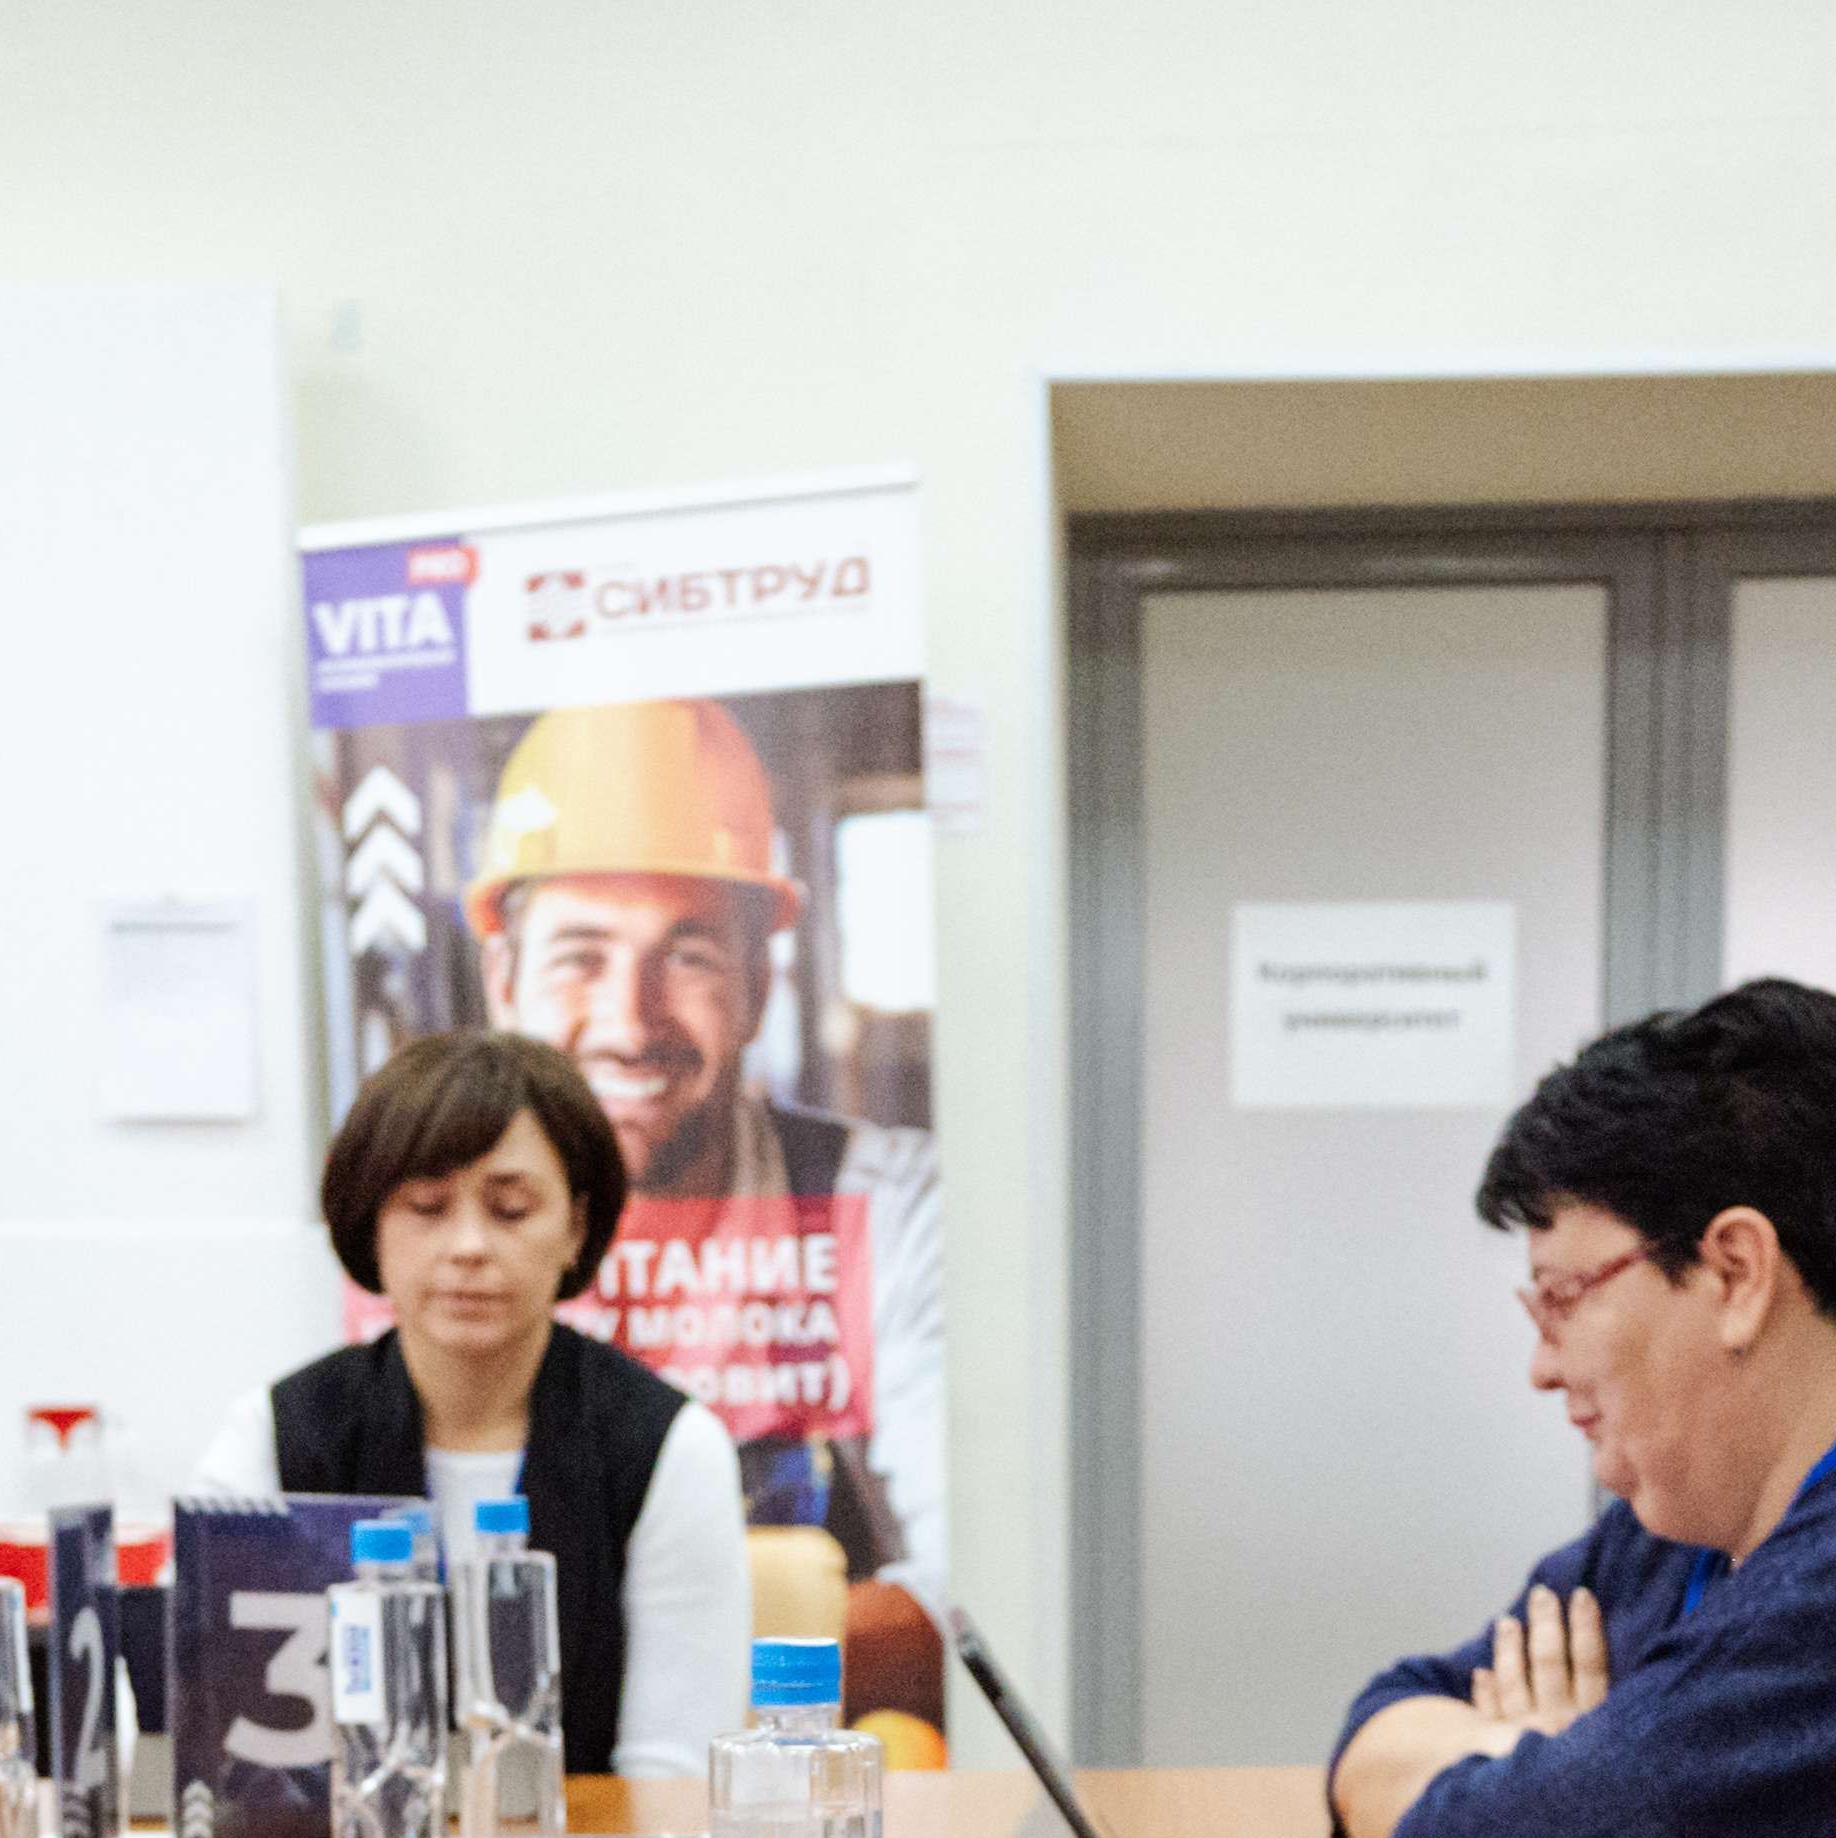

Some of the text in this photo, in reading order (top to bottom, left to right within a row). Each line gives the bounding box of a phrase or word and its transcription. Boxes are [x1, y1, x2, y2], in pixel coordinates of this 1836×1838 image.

[596, 556, 870, 620] СИБТРУД
[313, 591, 455, 656] VITA
[627, 1300, 838, 1346] МОЛОКА
[69, 1606, 108, 1797] 2
[223, 1590, 332, 1769] 3
